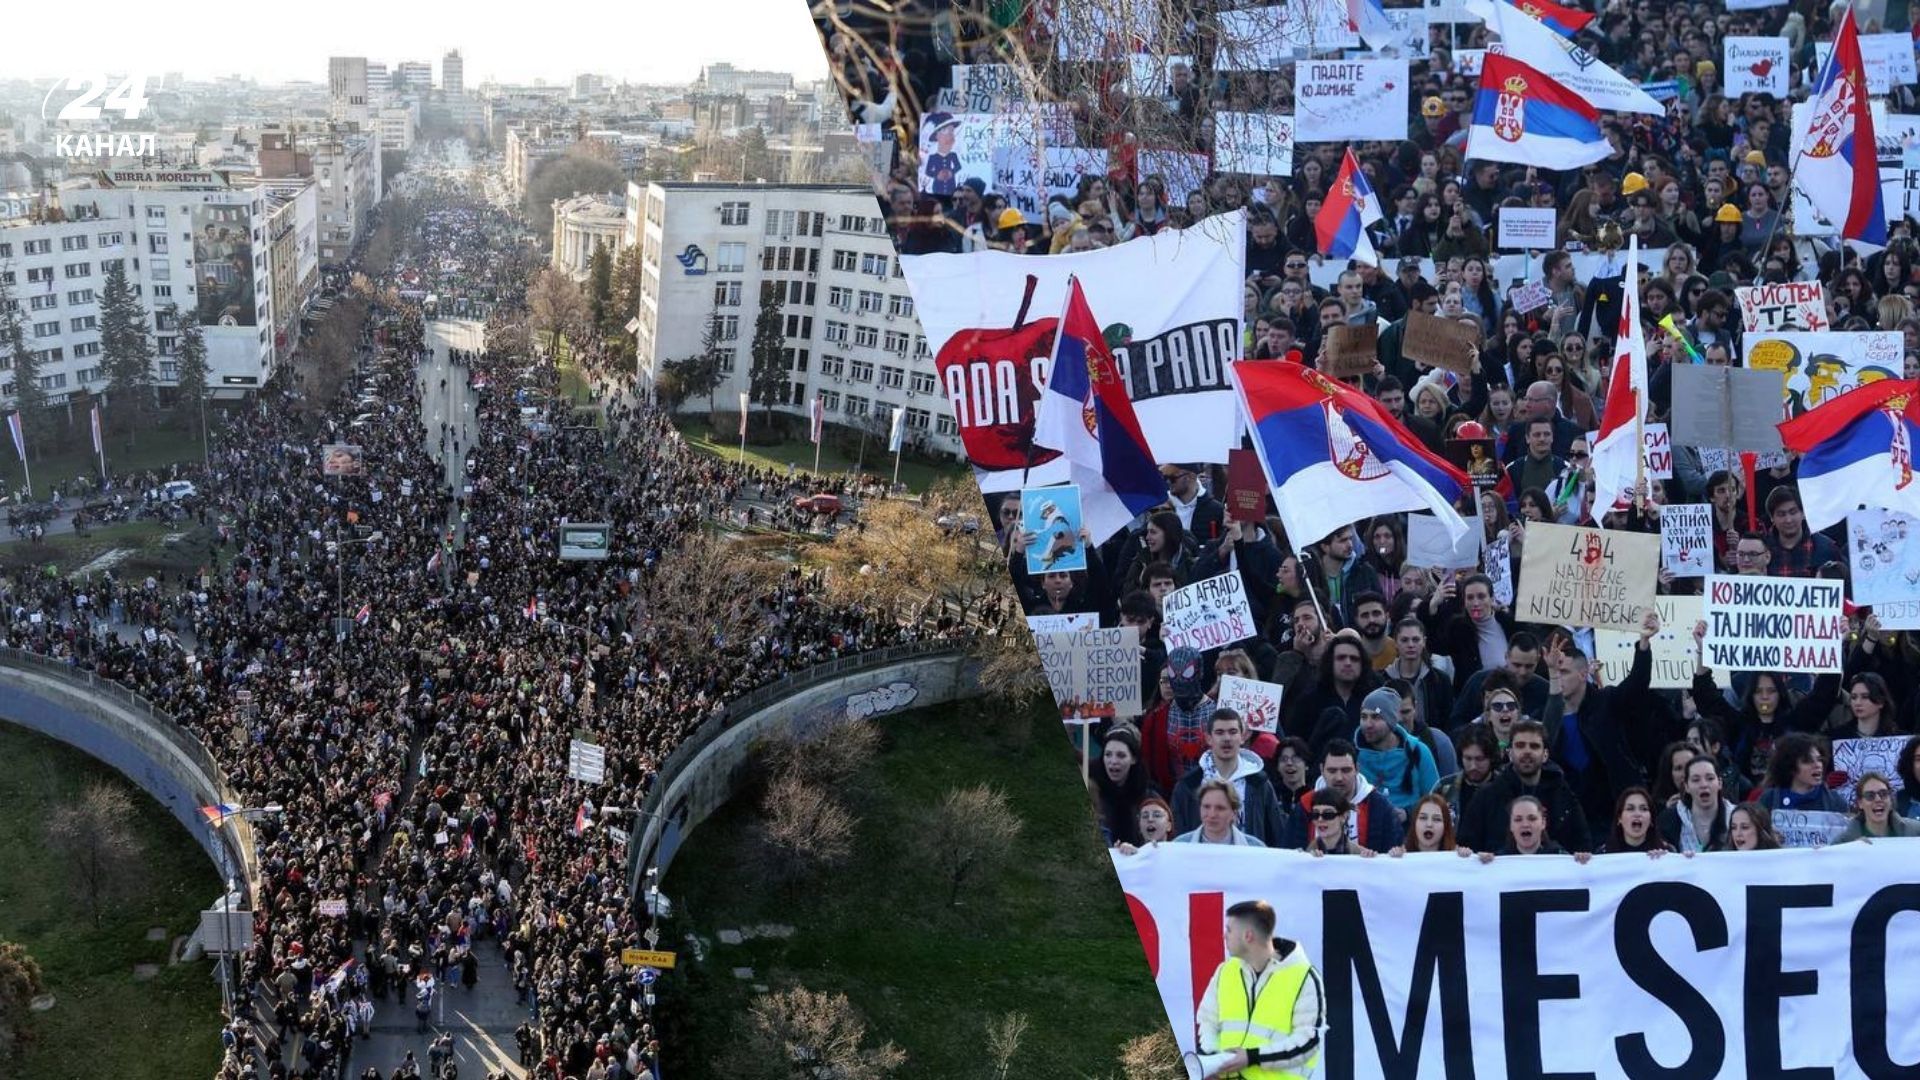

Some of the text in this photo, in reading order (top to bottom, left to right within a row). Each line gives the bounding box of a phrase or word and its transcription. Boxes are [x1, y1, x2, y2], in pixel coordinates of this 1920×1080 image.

[1311, 64, 1364, 81] ПАДАТЕ
[1315, 83, 1356, 97] ДОМИНЕ
[114, 172, 212, 183] BIRRA MORETTI
[1750, 282, 1821, 306] СИСТЕМ
[1759, 305, 1797, 325] ТЕ
[1145, 322, 1237, 394] PADA
[1662, 514, 1711, 528] КУПИМ
[1667, 536, 1707, 550] УЧИМ
[1196, 573, 1239, 604] AFRAID
[1550, 580, 1627, 601] INSTITUCIJE
[1530, 595, 1574, 620] NISU
[1710, 611, 1742, 638] ТАЈ
[1794, 614, 1839, 640] ПАДА
[1037, 633, 1056, 650] DA
[1086, 647, 1138, 665] KEROVI
[1708, 643, 1838, 668] ЧАК ИАКО ВЛАДА
[1086, 665, 1138, 685] KEROVI
[1086, 684, 1137, 703] KEROVI
